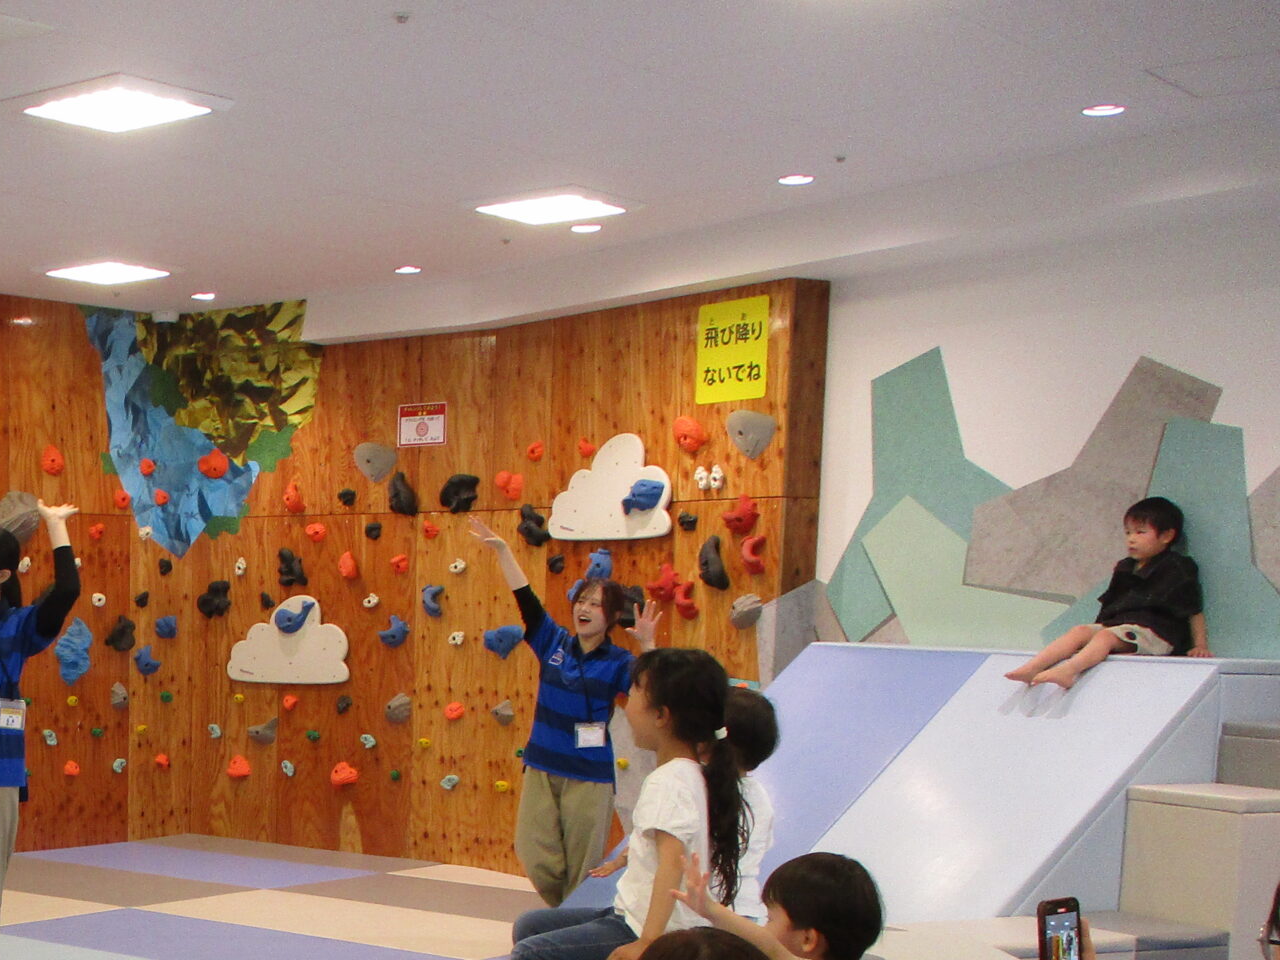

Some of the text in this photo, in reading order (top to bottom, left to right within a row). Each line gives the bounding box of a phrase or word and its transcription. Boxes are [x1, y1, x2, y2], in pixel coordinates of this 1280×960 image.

[704, 320, 763, 349] 飛び降り
[703, 361, 762, 386] ないでね
